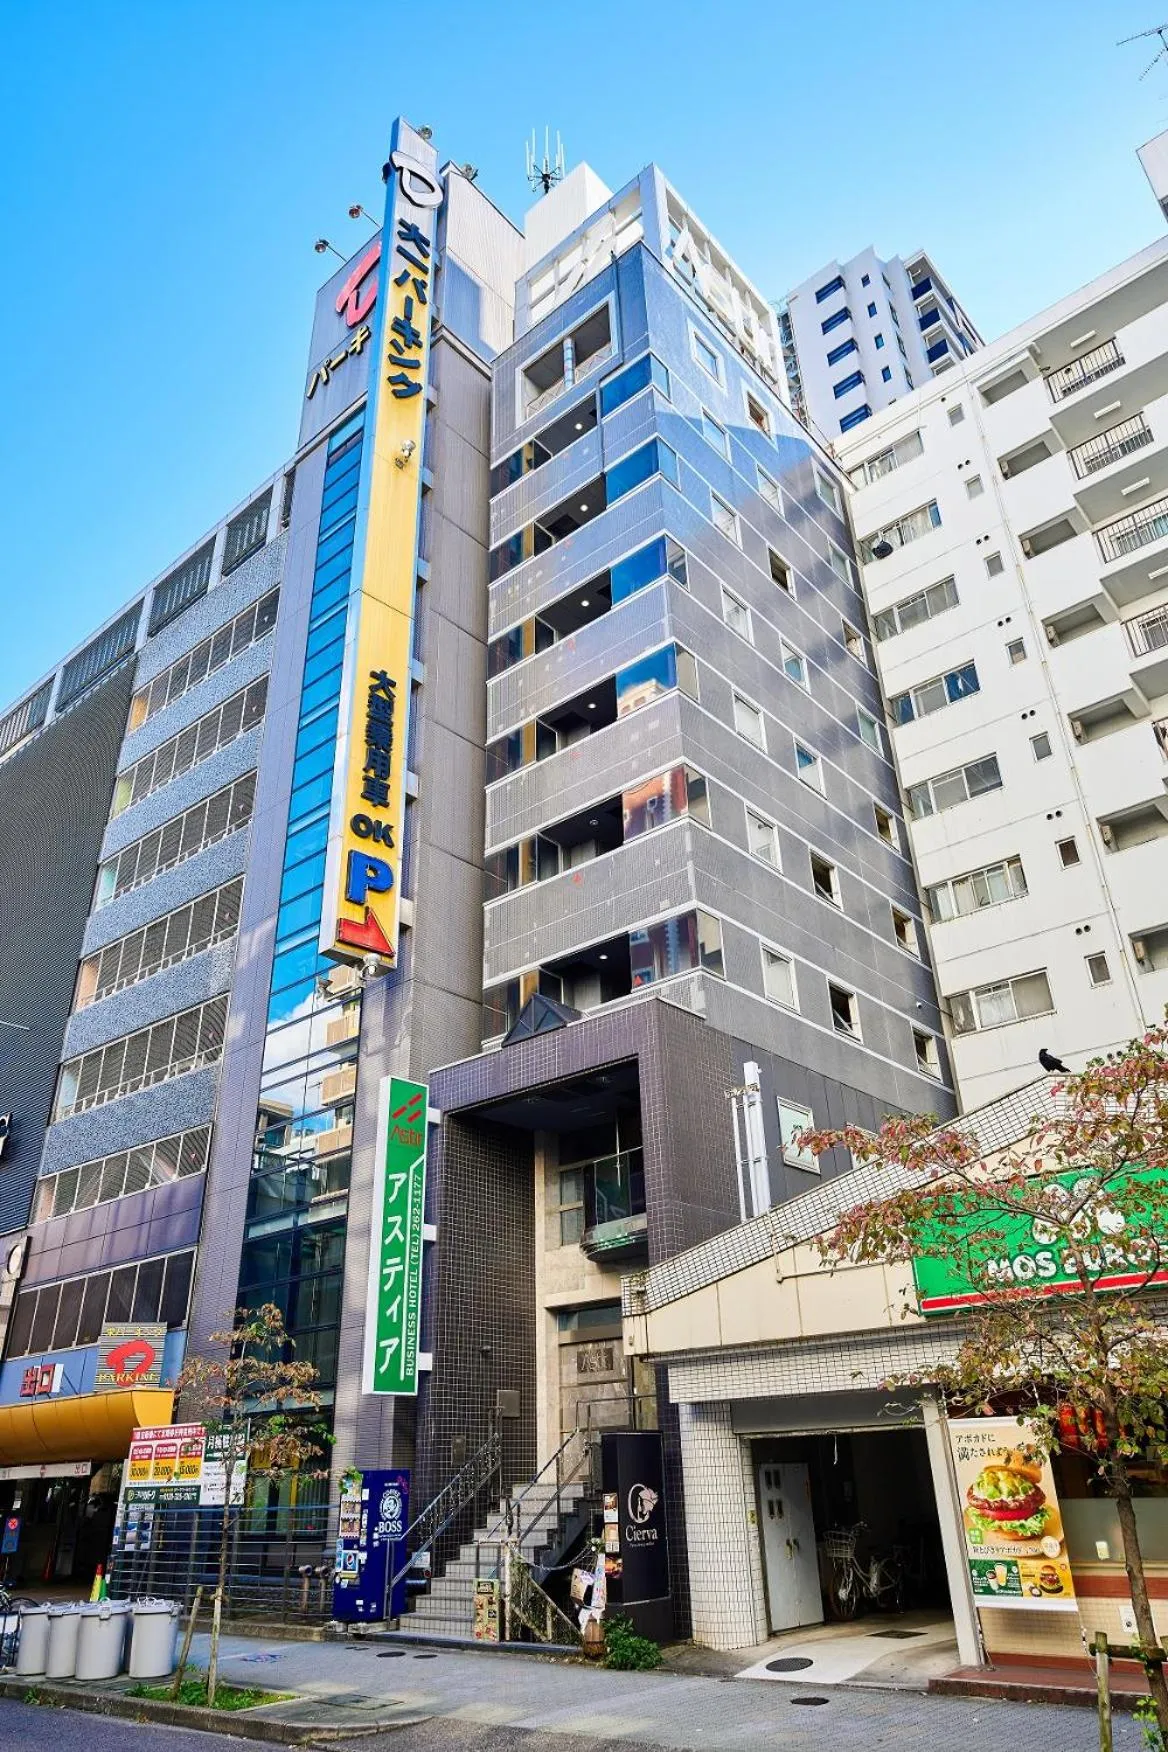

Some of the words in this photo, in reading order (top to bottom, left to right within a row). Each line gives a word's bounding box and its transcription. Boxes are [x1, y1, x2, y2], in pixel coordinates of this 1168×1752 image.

[350, 813, 395, 849] OK
[345, 849, 395, 906] P
[379, 1172, 407, 1375] アスティア
[987, 1251, 1057, 1283] MOS
[409, 1269, 418, 1308] HOTEL
[406, 1312, 416, 1376] BUSINESS
[20, 1363, 57, 1398] 出口
[955, 1433, 996, 1444] アボカドに
[378, 1520, 403, 1534] BOSS
[625, 1524, 658, 1542] Cierva
